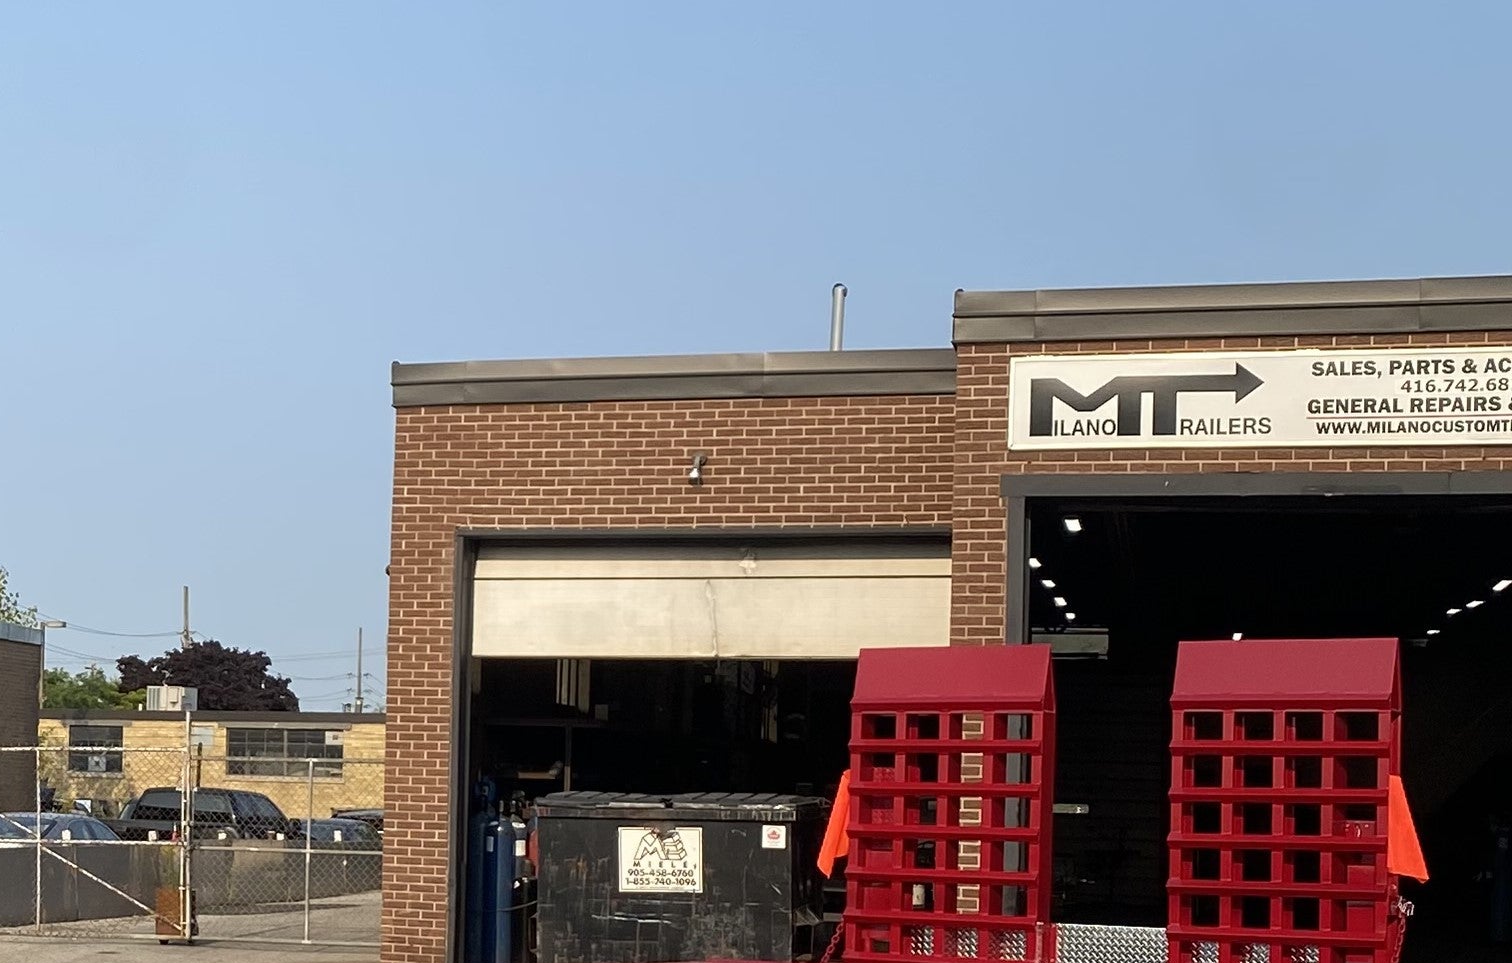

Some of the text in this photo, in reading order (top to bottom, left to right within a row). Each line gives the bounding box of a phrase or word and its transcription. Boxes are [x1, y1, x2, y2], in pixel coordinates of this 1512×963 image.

[1311, 360, 1382, 378] SALES,
[1389, 359, 1455, 375] PARTS
[1461, 358, 1477, 373] &
[1307, 399, 1404, 414] GENERAL
[1409, 396, 1502, 413] REPAIRS
[1316, 420, 1512, 434] WWW.MILANOCUSTOMT
